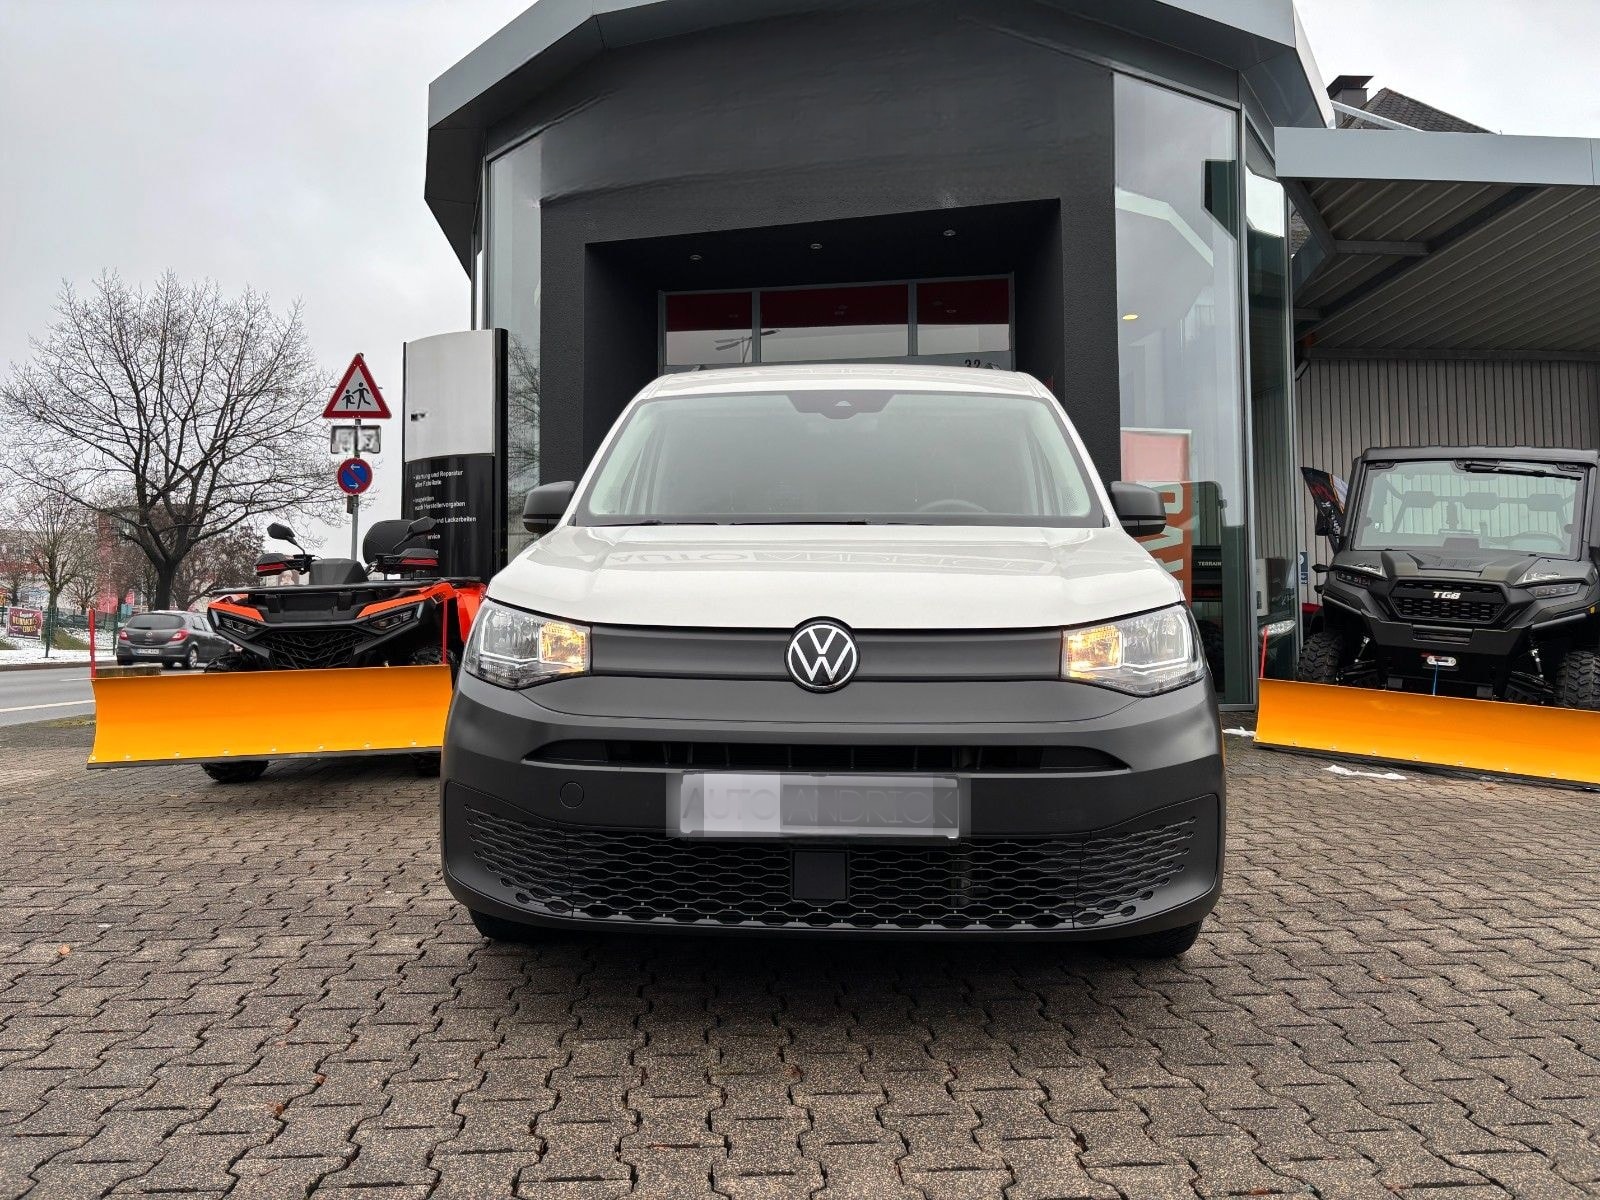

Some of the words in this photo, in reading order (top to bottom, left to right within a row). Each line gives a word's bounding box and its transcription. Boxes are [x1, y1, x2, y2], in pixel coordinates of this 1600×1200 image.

[444, 515, 477, 524] Lackarbeiten
[682, 787, 778, 821] AUTO
[787, 789, 954, 825] ANDRICK
